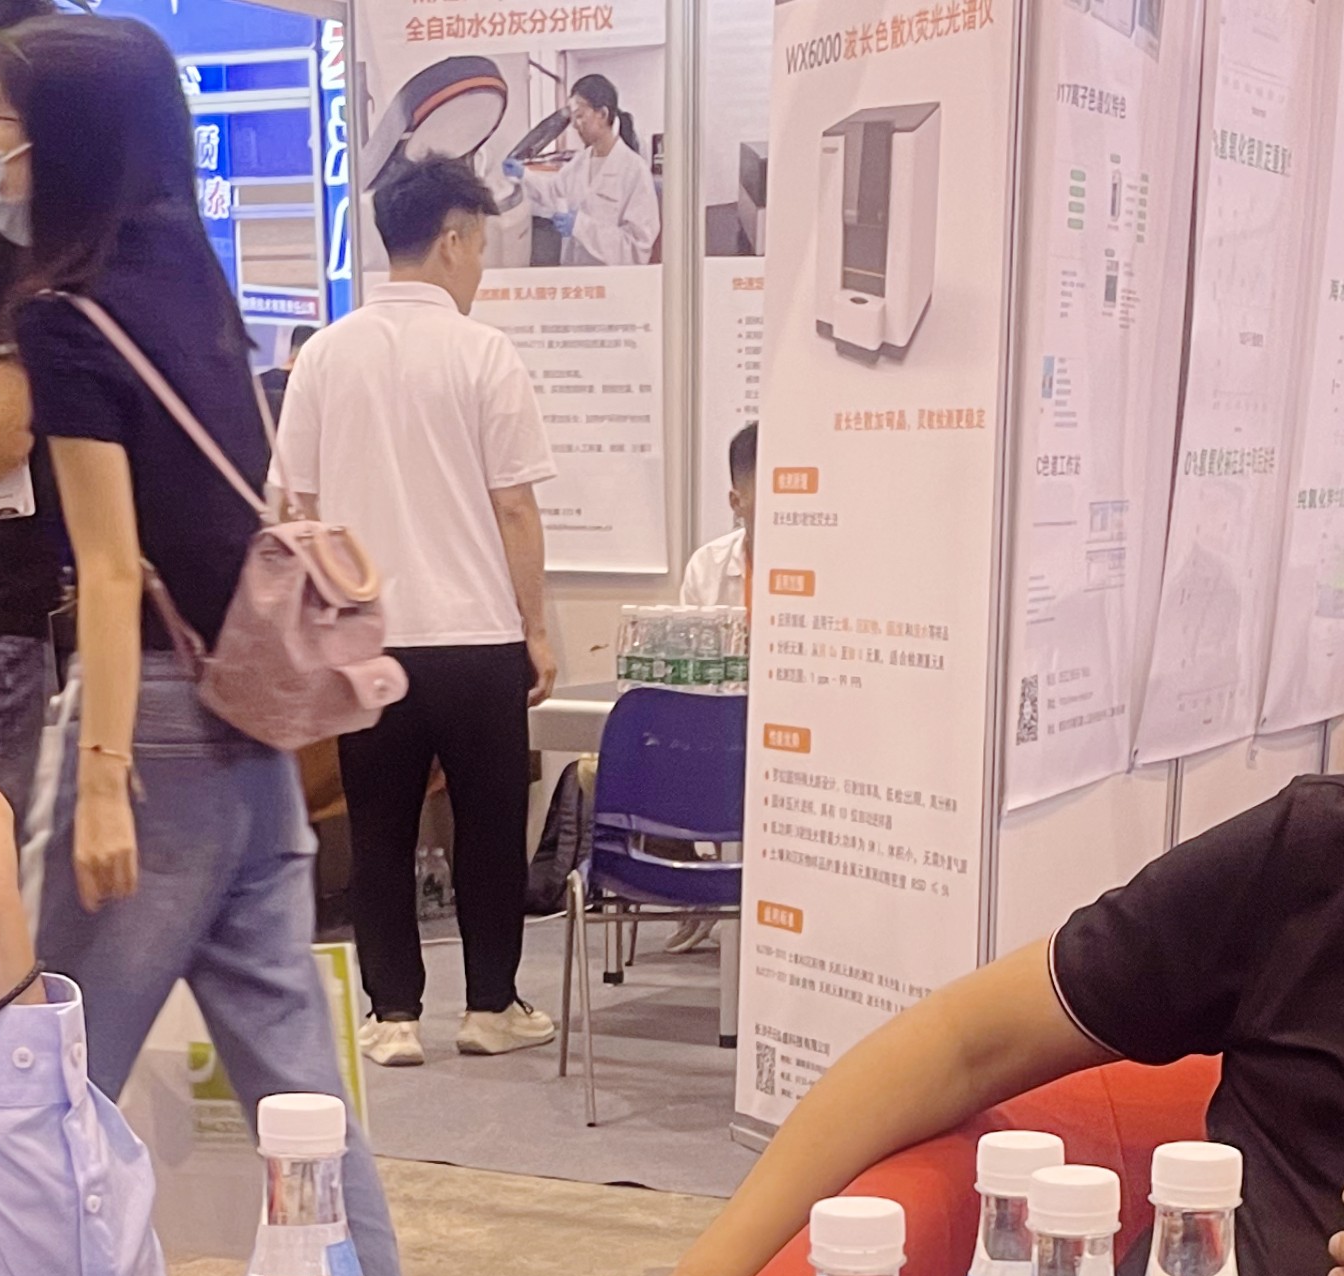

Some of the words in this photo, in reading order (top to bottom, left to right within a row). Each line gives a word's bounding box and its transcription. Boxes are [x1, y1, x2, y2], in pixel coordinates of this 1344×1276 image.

[406, 5, 614, 42] 全自动水分灰分分析仪
[786, 31, 842, 75] WX6000
